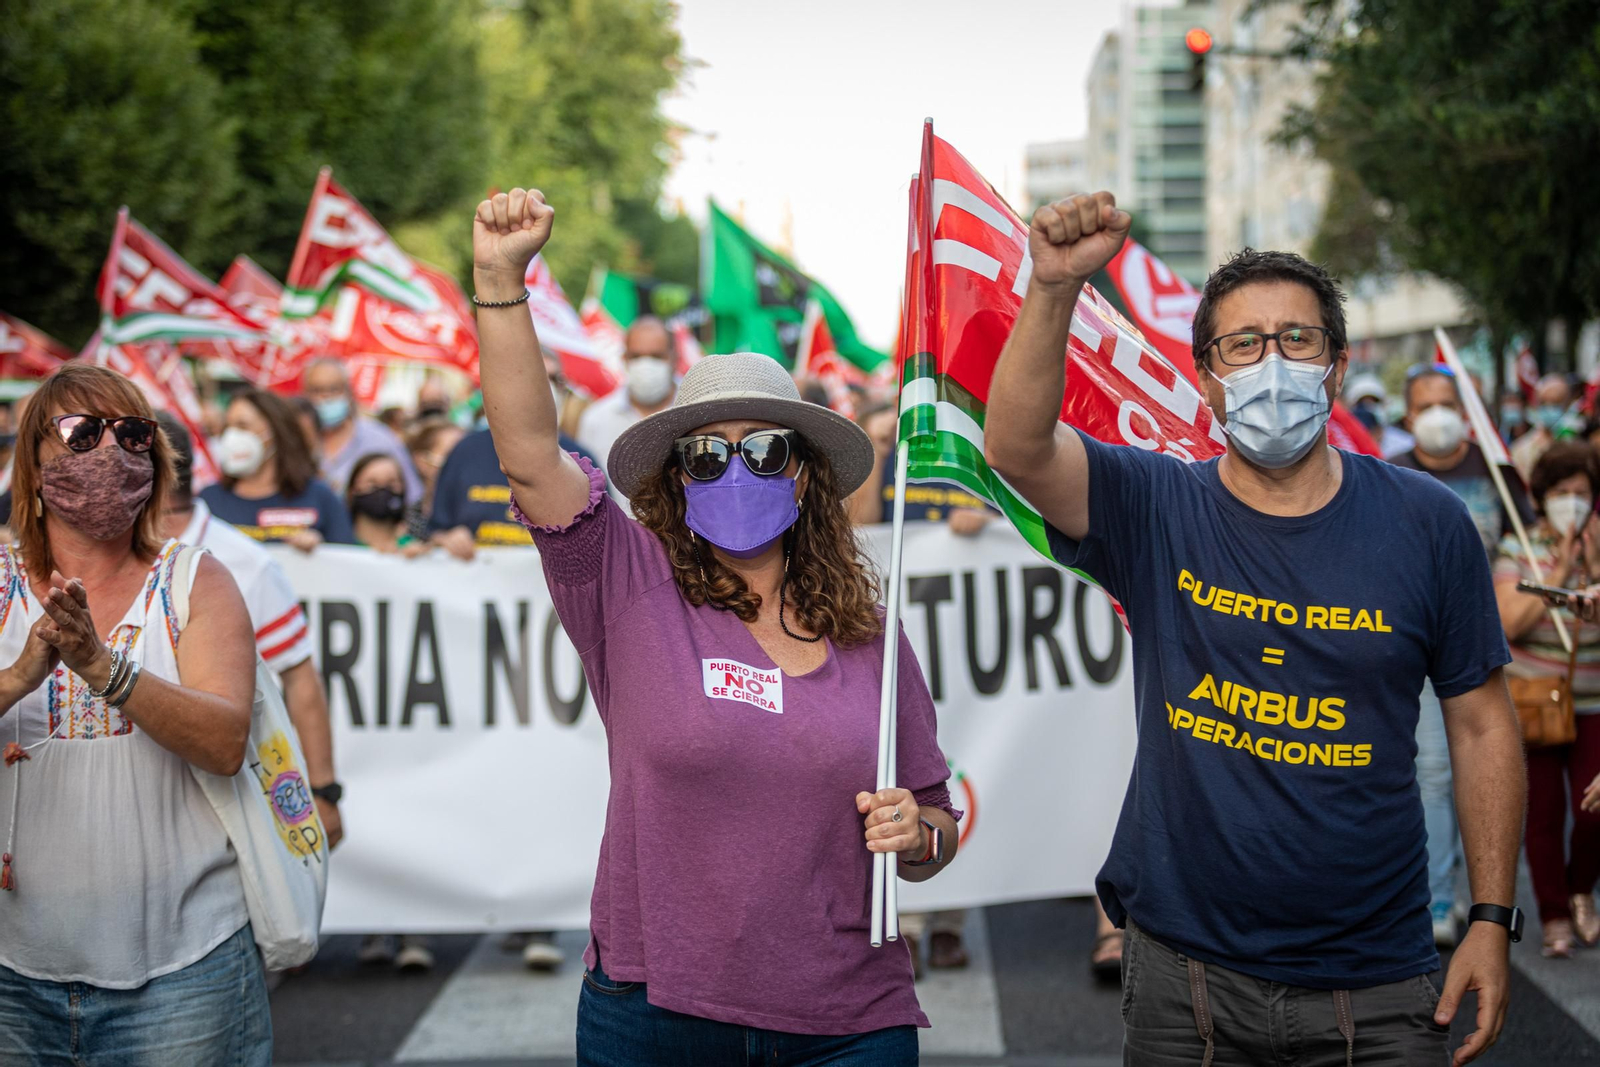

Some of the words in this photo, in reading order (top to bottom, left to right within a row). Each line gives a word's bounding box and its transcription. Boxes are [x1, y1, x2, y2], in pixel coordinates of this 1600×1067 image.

[1177, 568, 1299, 625] PUERTO
[1305, 605, 1393, 633] REAL
[299, 601, 450, 726] RIA
[887, 566, 1123, 700] TURO
[710, 662, 750, 677] PUERTO
[752, 671, 778, 684] REAL
[725, 672, 764, 695] NO
[712, 686, 728, 696] SE
[732, 689, 777, 711] CIERRA
[1187, 673, 1346, 731] AIRBUS
